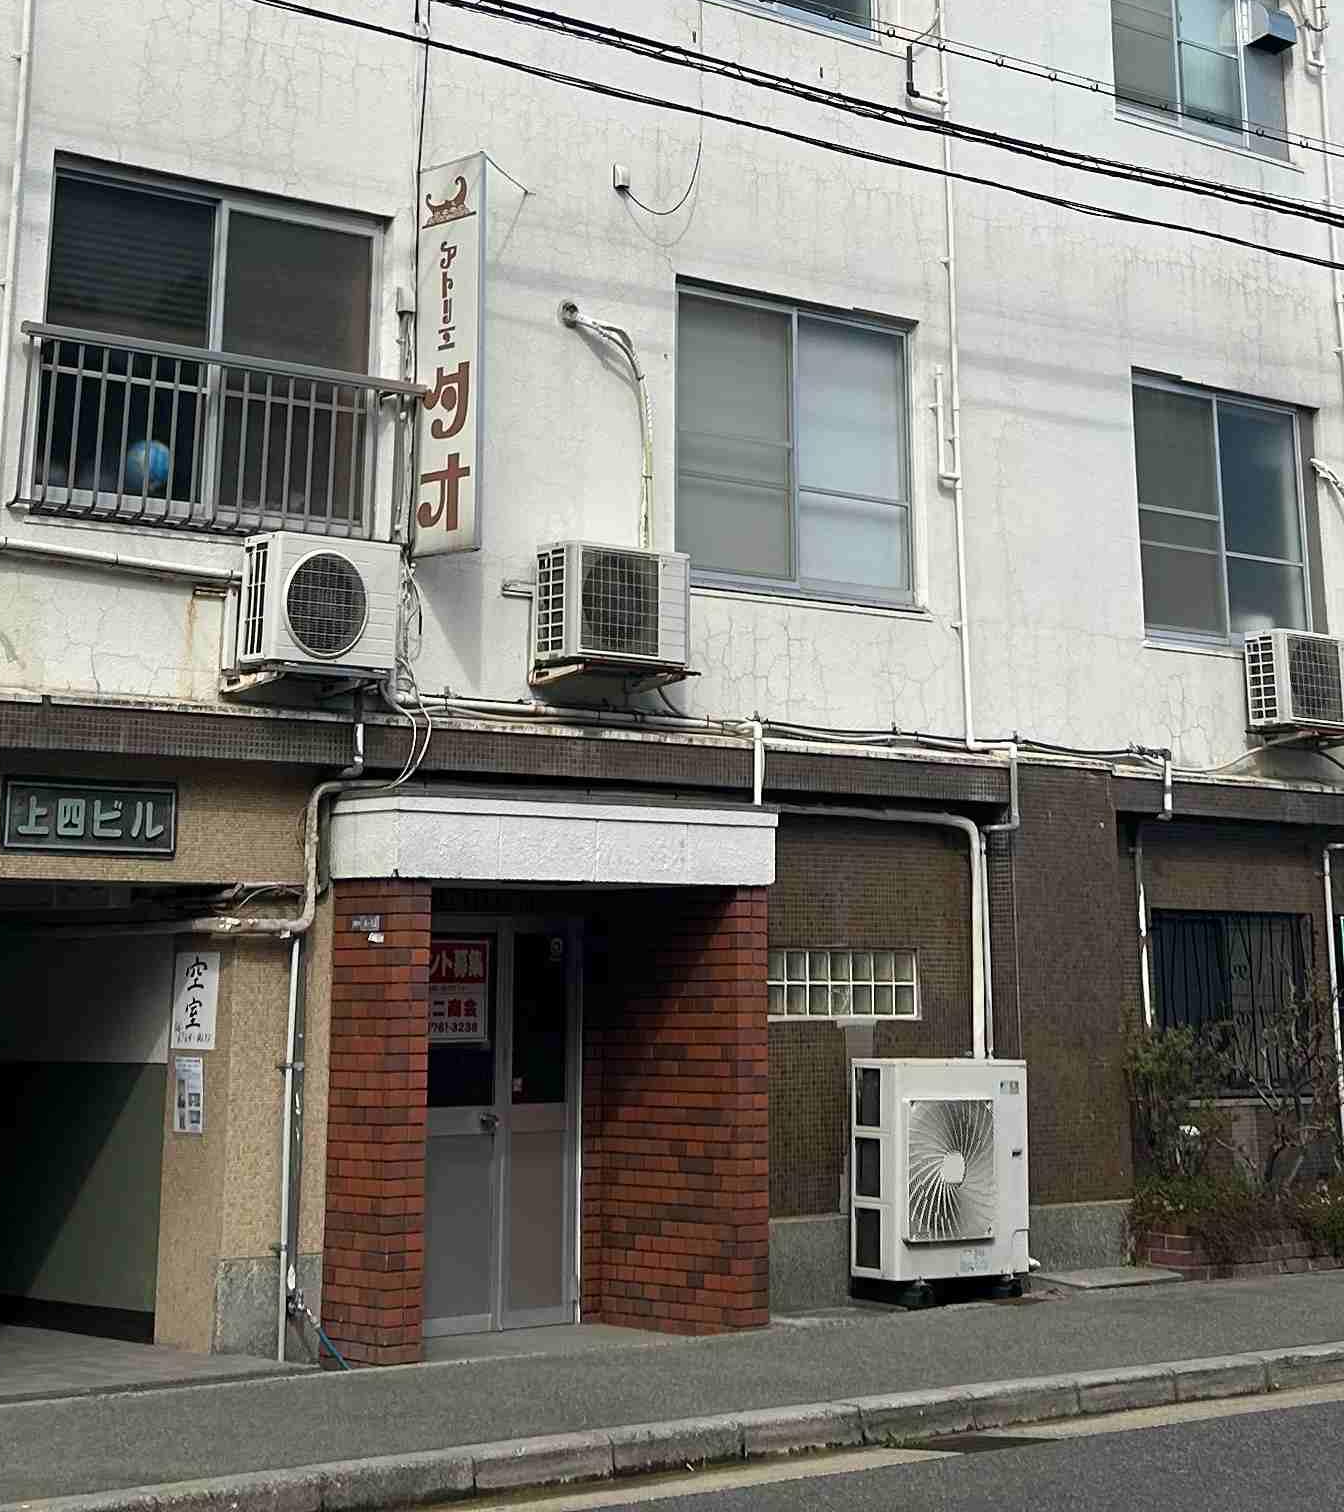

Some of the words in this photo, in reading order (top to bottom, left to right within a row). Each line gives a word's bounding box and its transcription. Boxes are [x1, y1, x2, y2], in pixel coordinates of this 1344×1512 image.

[437, 240, 458, 351] アトリエ
[417, 361, 471, 532] タオ
[16, 794, 165, 840] 上四ビル
[184, 955, 208, 1030] 空室
[429, 999, 478, 1017] 二商会
